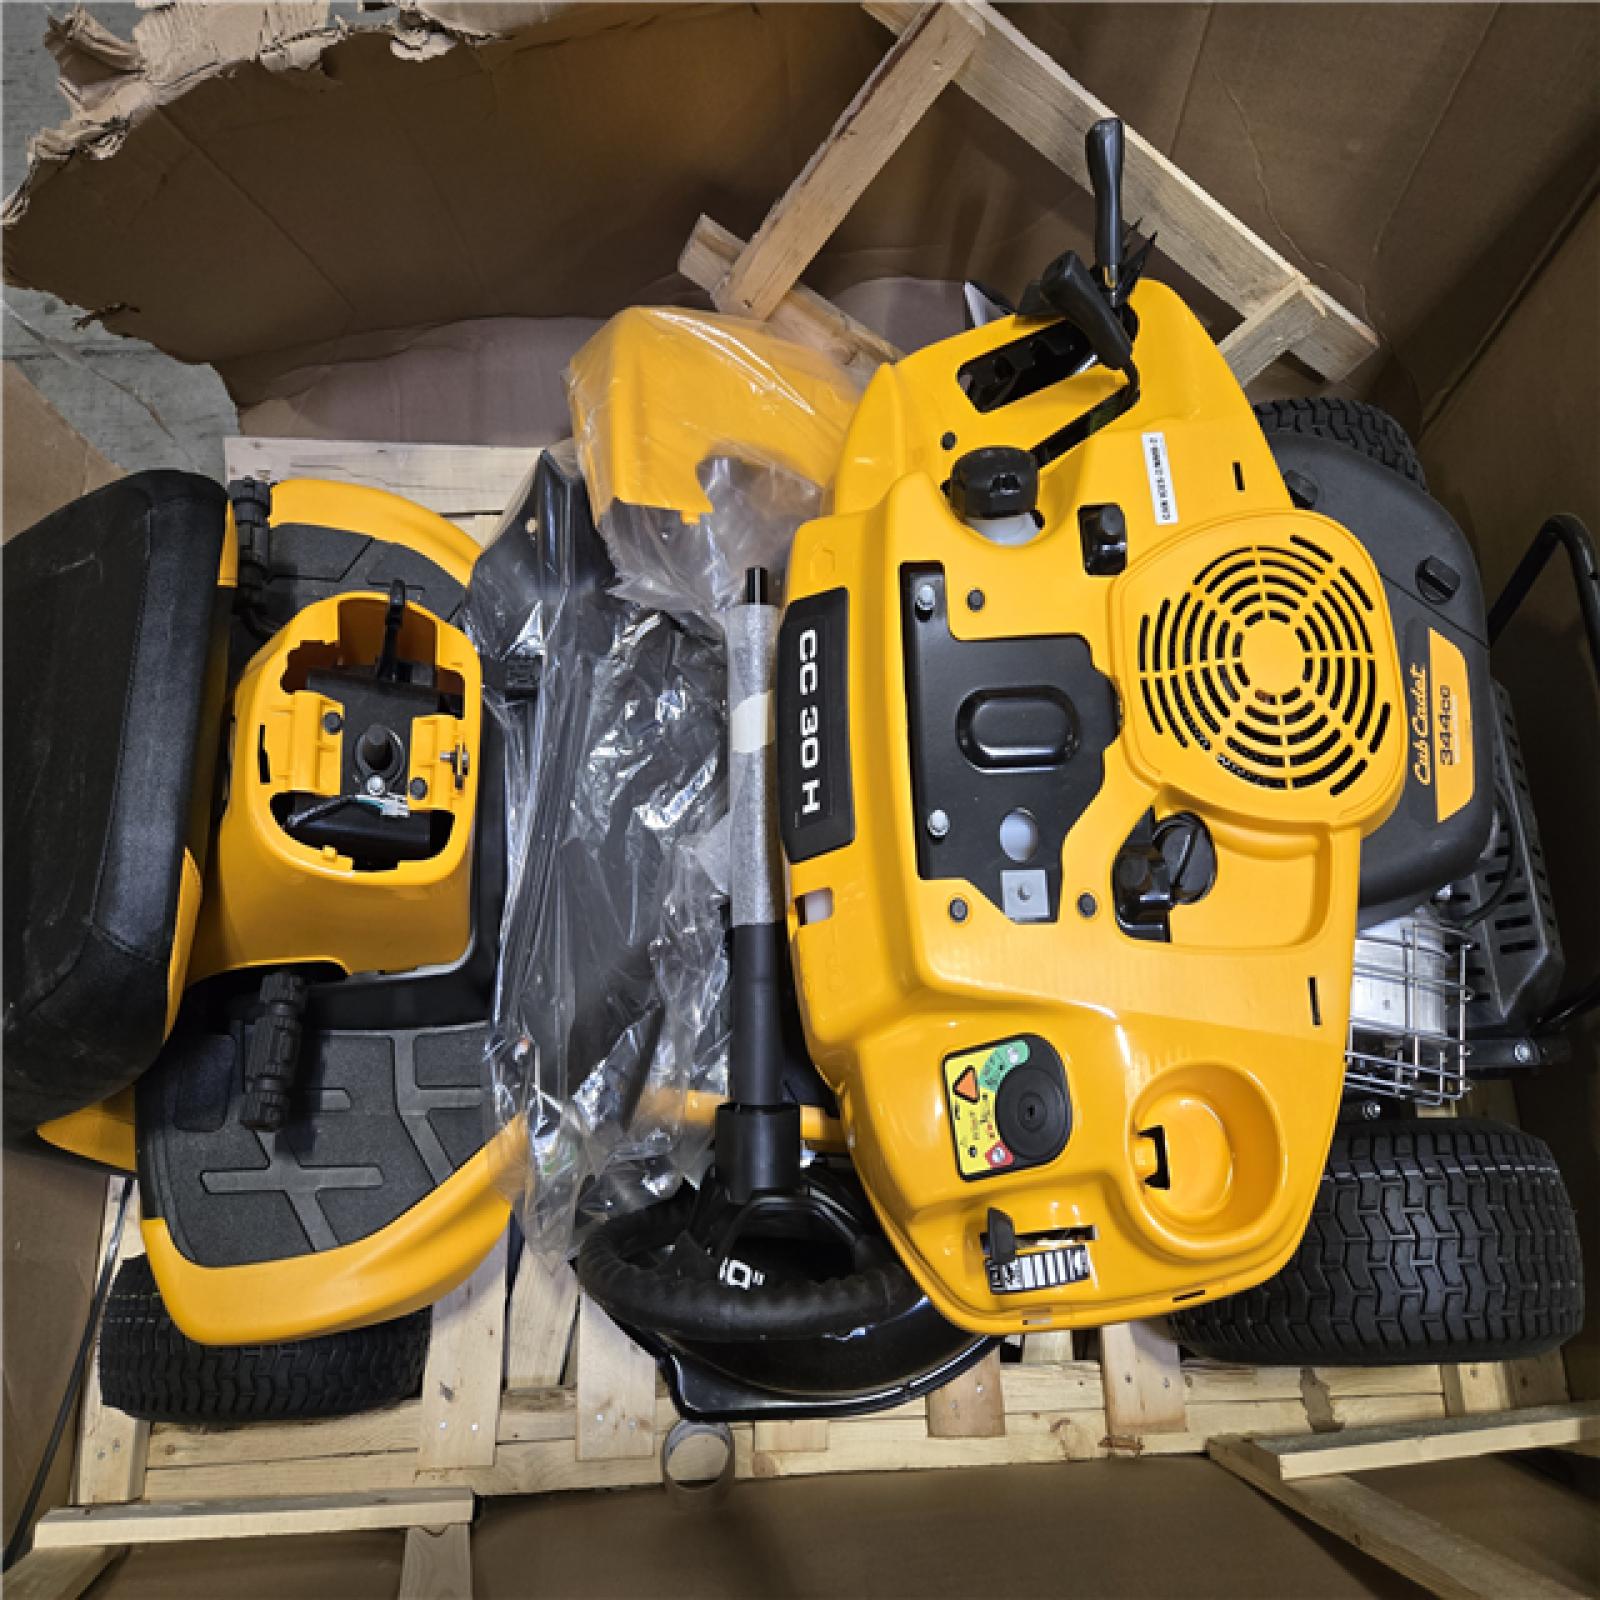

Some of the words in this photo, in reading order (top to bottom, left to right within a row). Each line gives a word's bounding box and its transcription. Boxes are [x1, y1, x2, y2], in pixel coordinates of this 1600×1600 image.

[799, 629, 818, 695] CC
[1409, 662, 1428, 738] Cadet
[800, 705, 820, 769] 30
[1411, 739, 1431, 785] Cub
[802, 779, 821, 816] H
